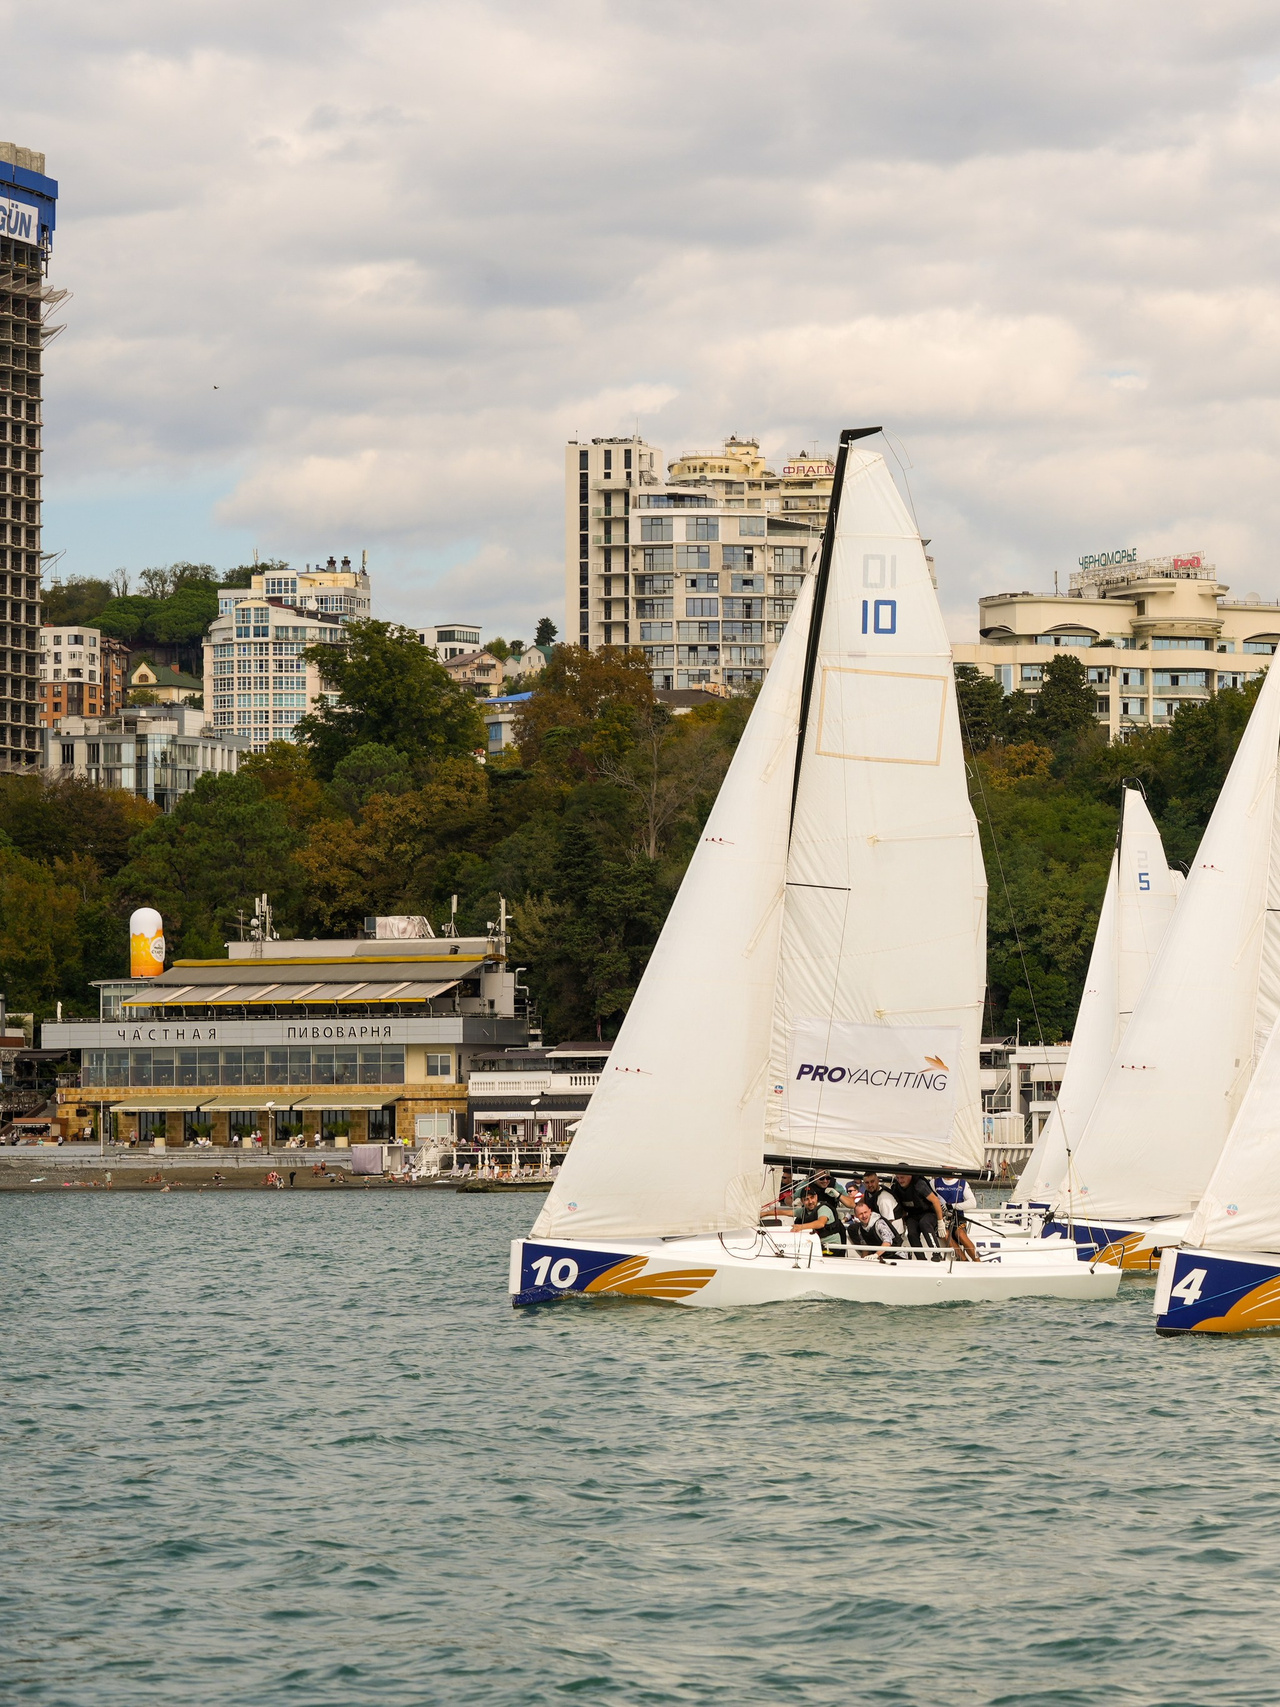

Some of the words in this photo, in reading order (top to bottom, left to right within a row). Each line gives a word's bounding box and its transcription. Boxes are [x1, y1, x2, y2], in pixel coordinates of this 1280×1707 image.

[782, 465, 837, 475] ФЛАГМ
[1078, 548, 1137, 570] ЧЕРНОМОРЬЕ
[861, 599, 897, 635] 10
[1138, 872, 1150, 891] 5
[117, 1028, 218, 1041] ЧАСТНАЯ
[287, 1026, 392, 1039] ПИВОВАРНЯ
[796, 1063, 948, 1092] PROYACHTING
[530, 1255, 579, 1289] 10
[1170, 1268, 1208, 1306] 4
